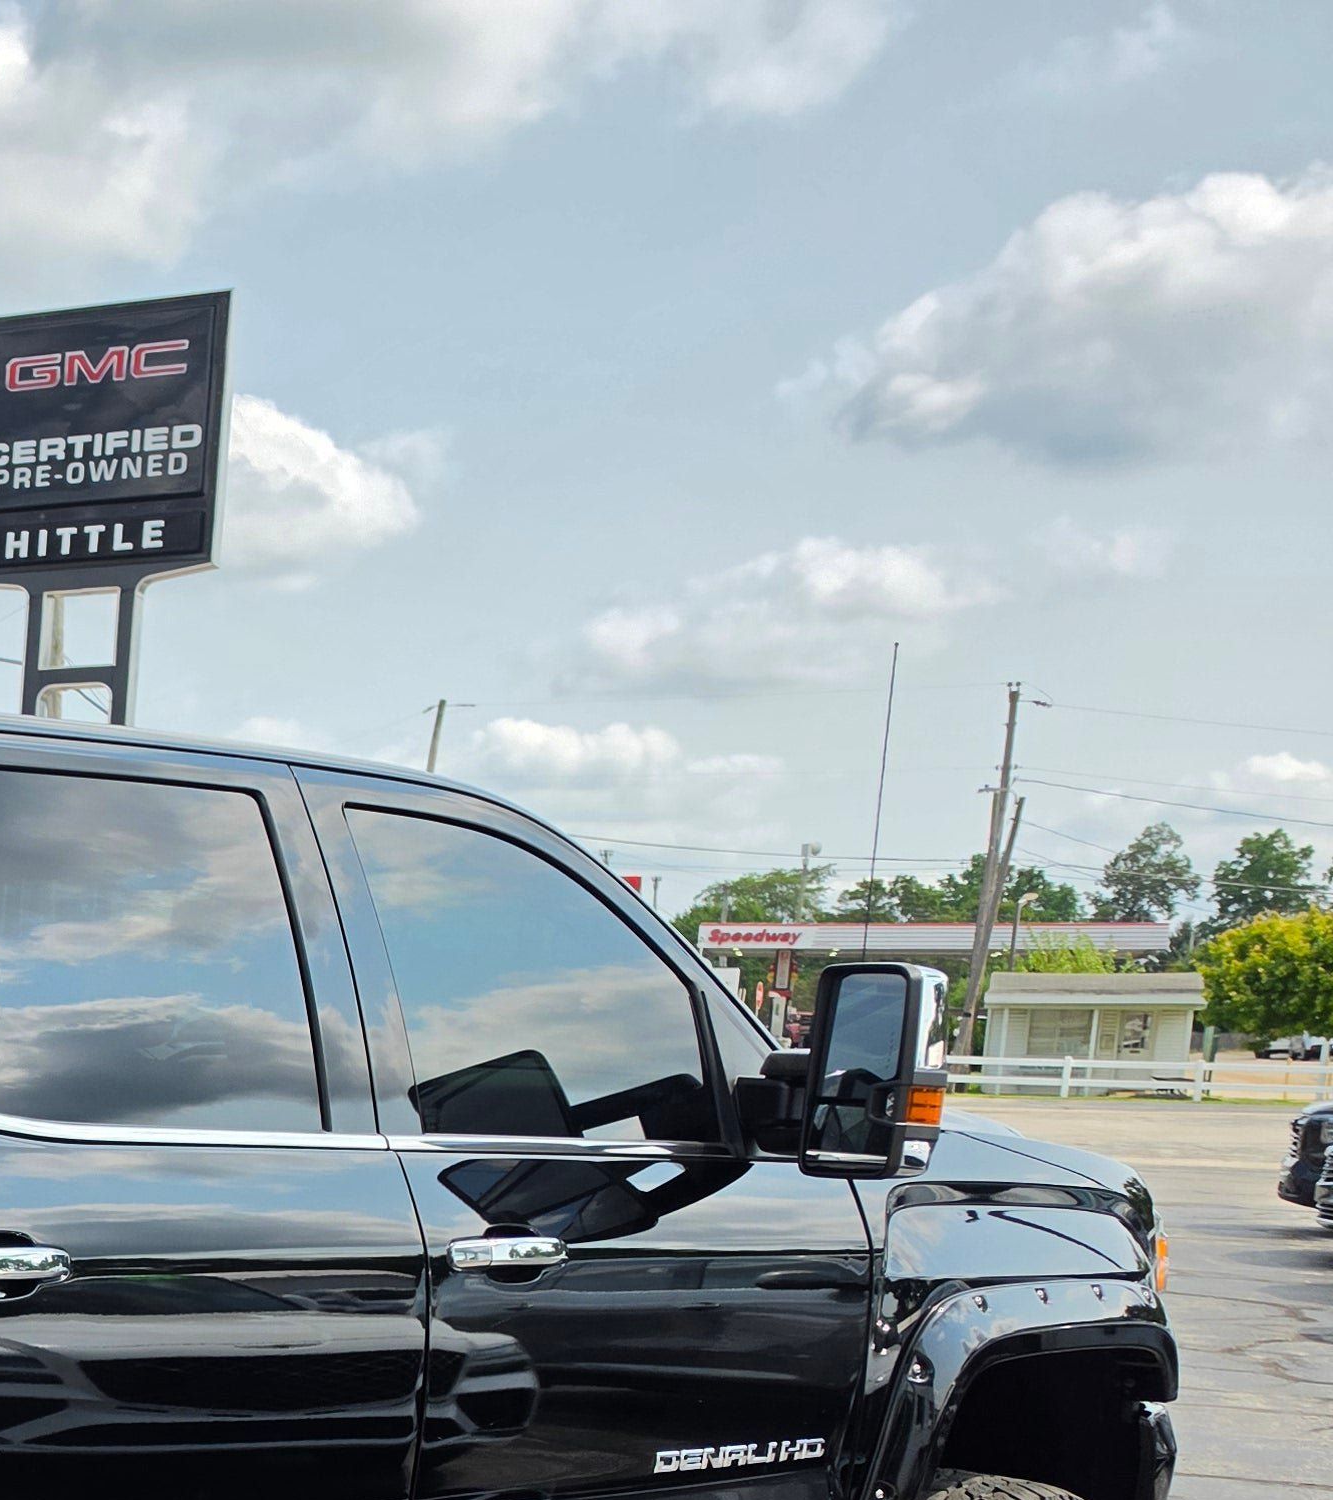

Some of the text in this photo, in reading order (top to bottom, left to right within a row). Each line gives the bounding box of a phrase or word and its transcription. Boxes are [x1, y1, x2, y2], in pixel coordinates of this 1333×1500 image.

[5, 339, 189, 392] GMC
[4, 520, 165, 560] HITTLE
[708, 928, 803, 946] Speedway
[653, 1437, 826, 1473] DENALI HD
